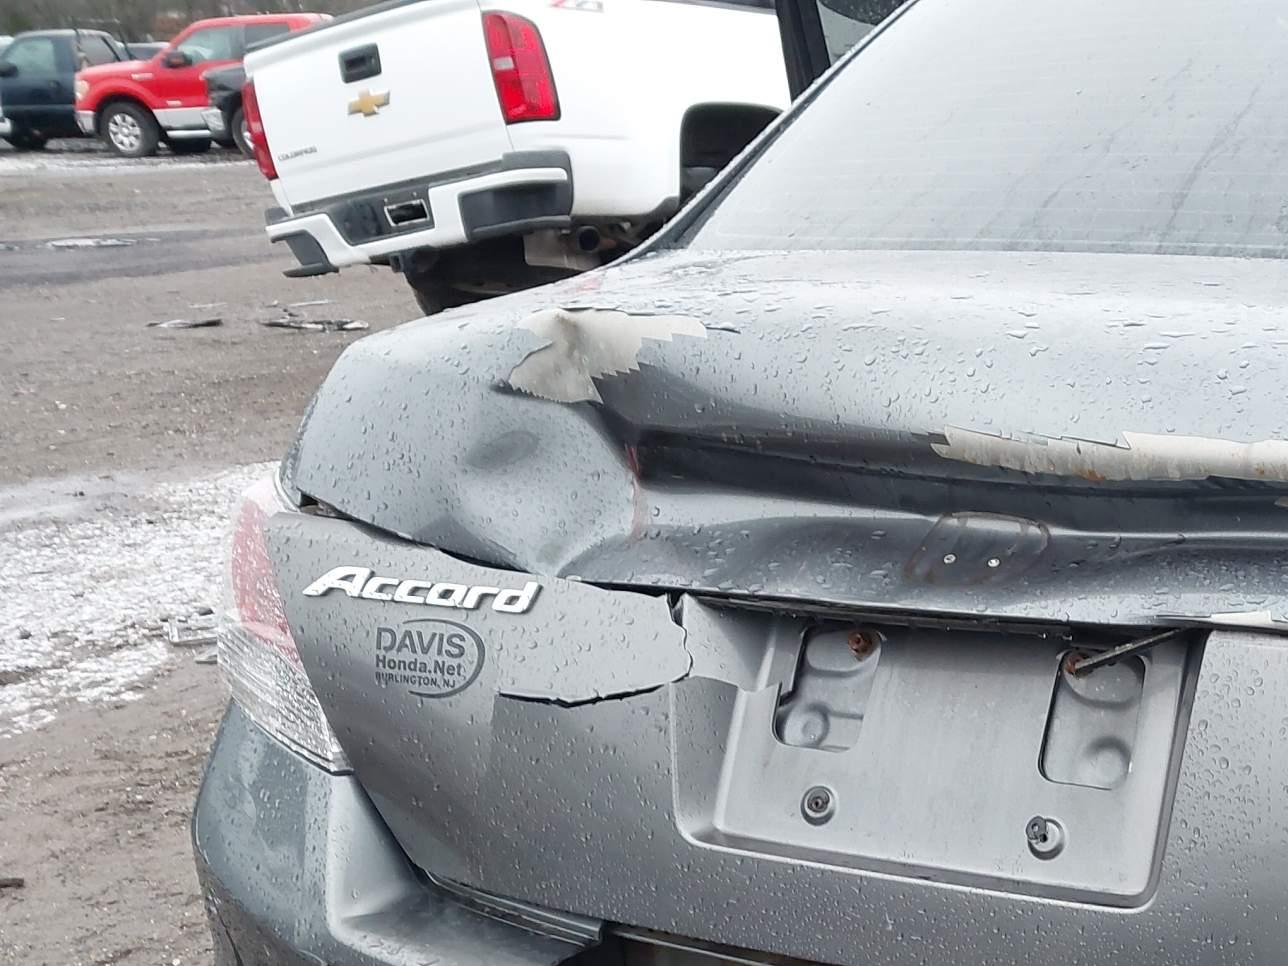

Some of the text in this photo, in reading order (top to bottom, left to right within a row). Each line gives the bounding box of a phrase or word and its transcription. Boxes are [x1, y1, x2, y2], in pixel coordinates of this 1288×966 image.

[302, 566, 542, 613] Accord
[376, 626, 466, 658] DAVIS
[375, 654, 463, 677] Honda.Net
[443, 678, 456, 688] NJ
